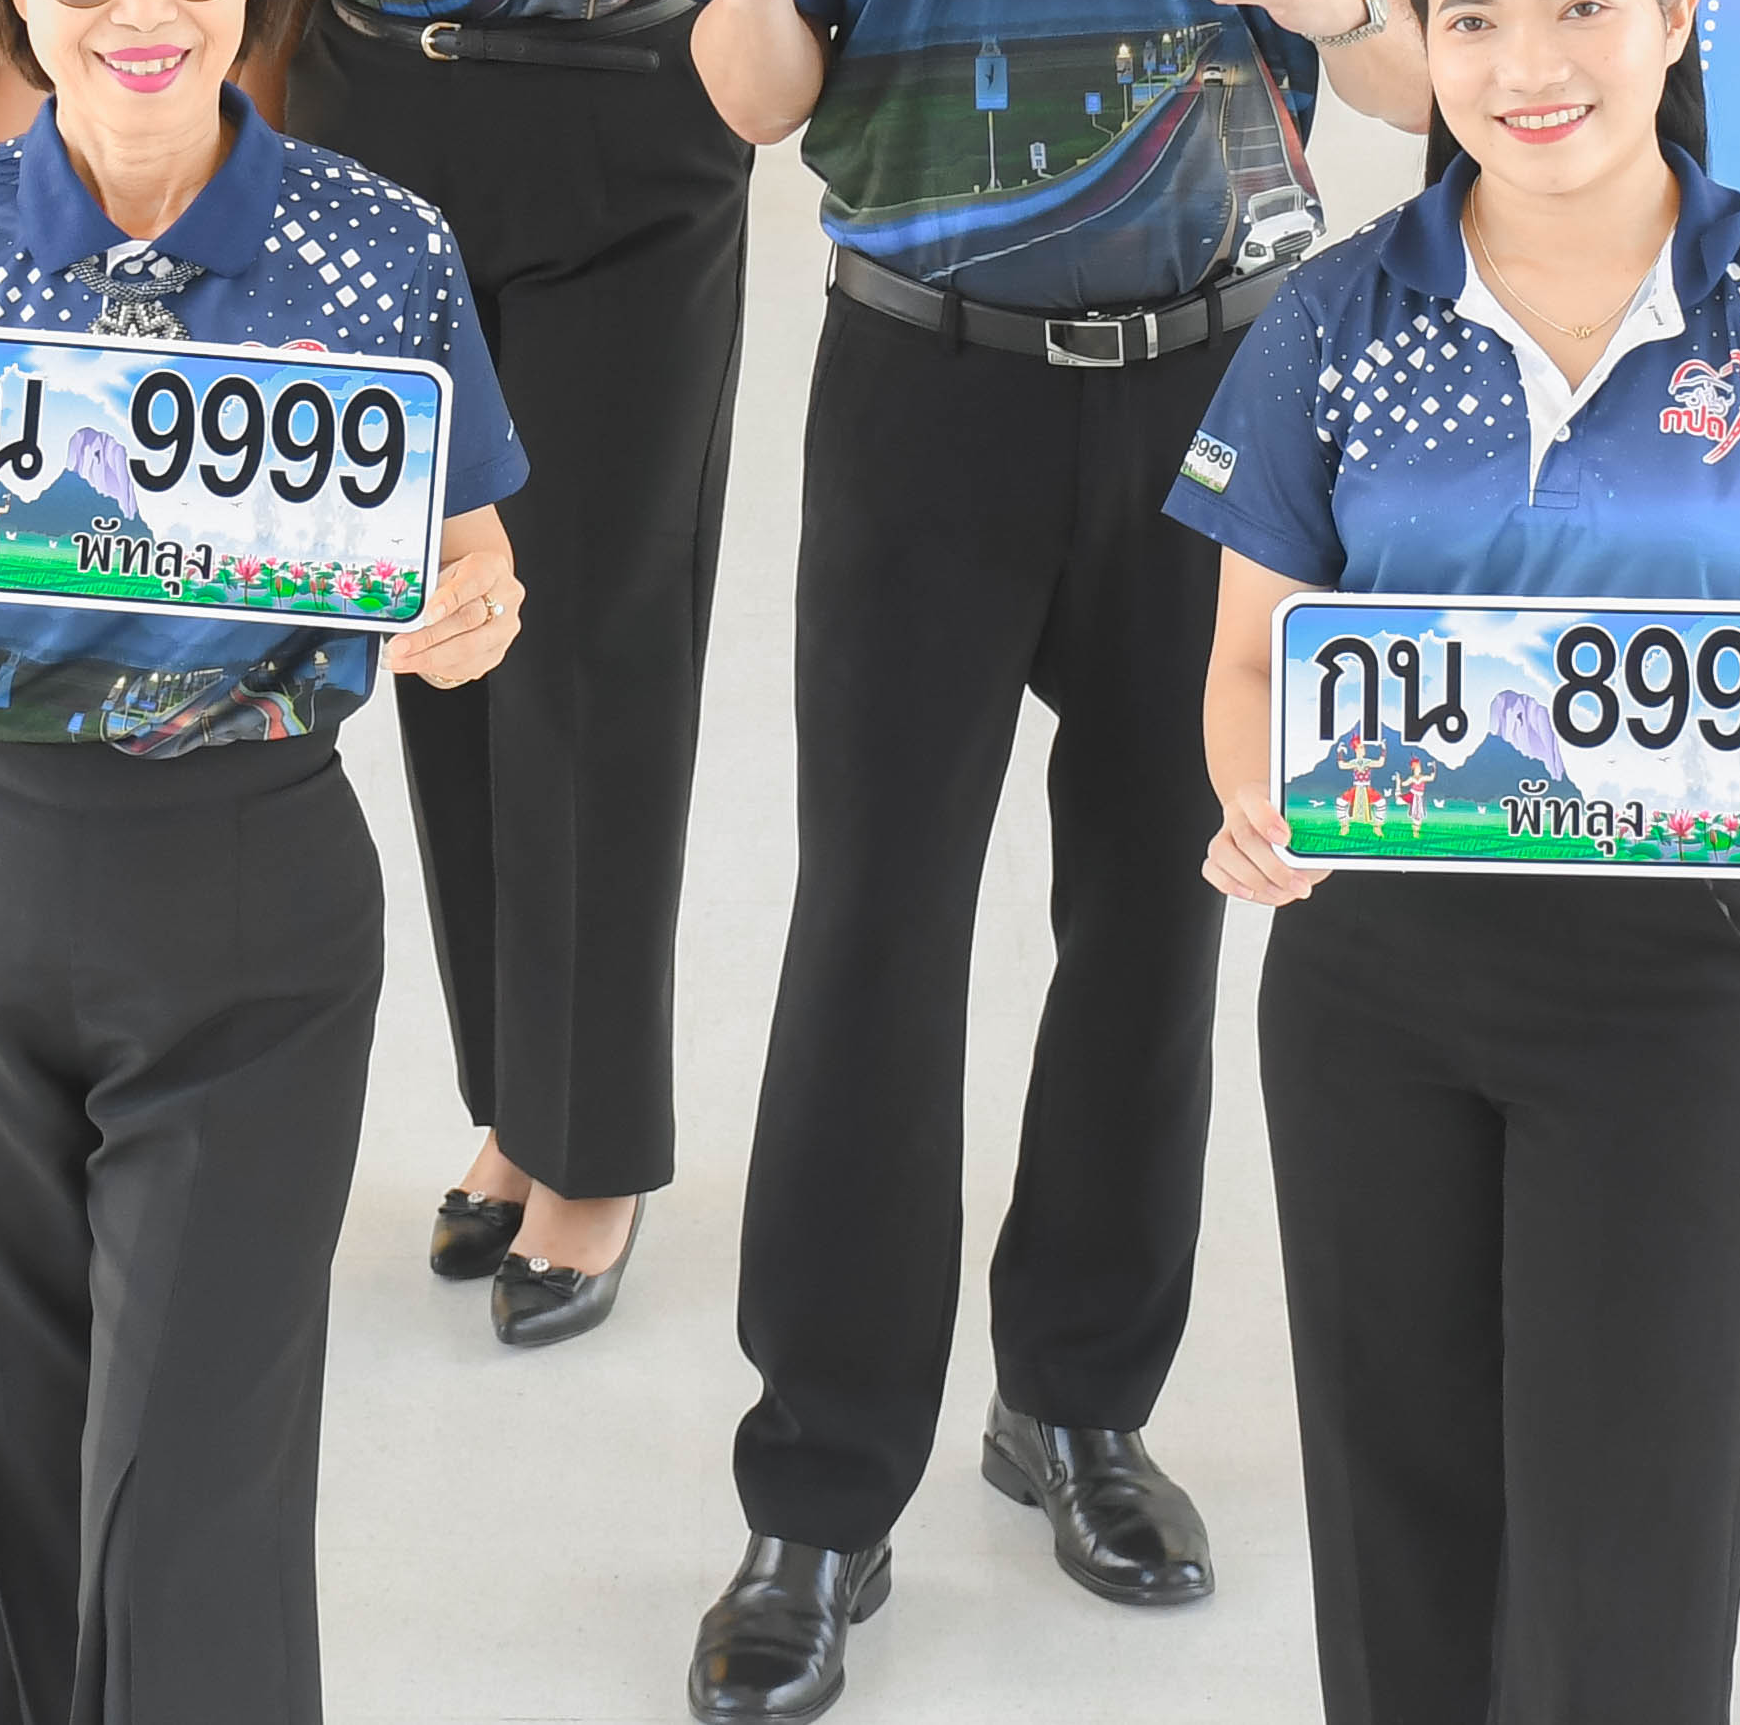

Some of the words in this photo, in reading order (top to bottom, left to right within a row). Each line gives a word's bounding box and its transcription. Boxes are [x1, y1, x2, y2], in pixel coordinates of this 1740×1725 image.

[129, 370, 407, 508] 9999
[73, 518, 214, 597] พัทลุง
[1314, 636, 1468, 745] กน
[1502, 781, 1644, 856] พัทลุง
